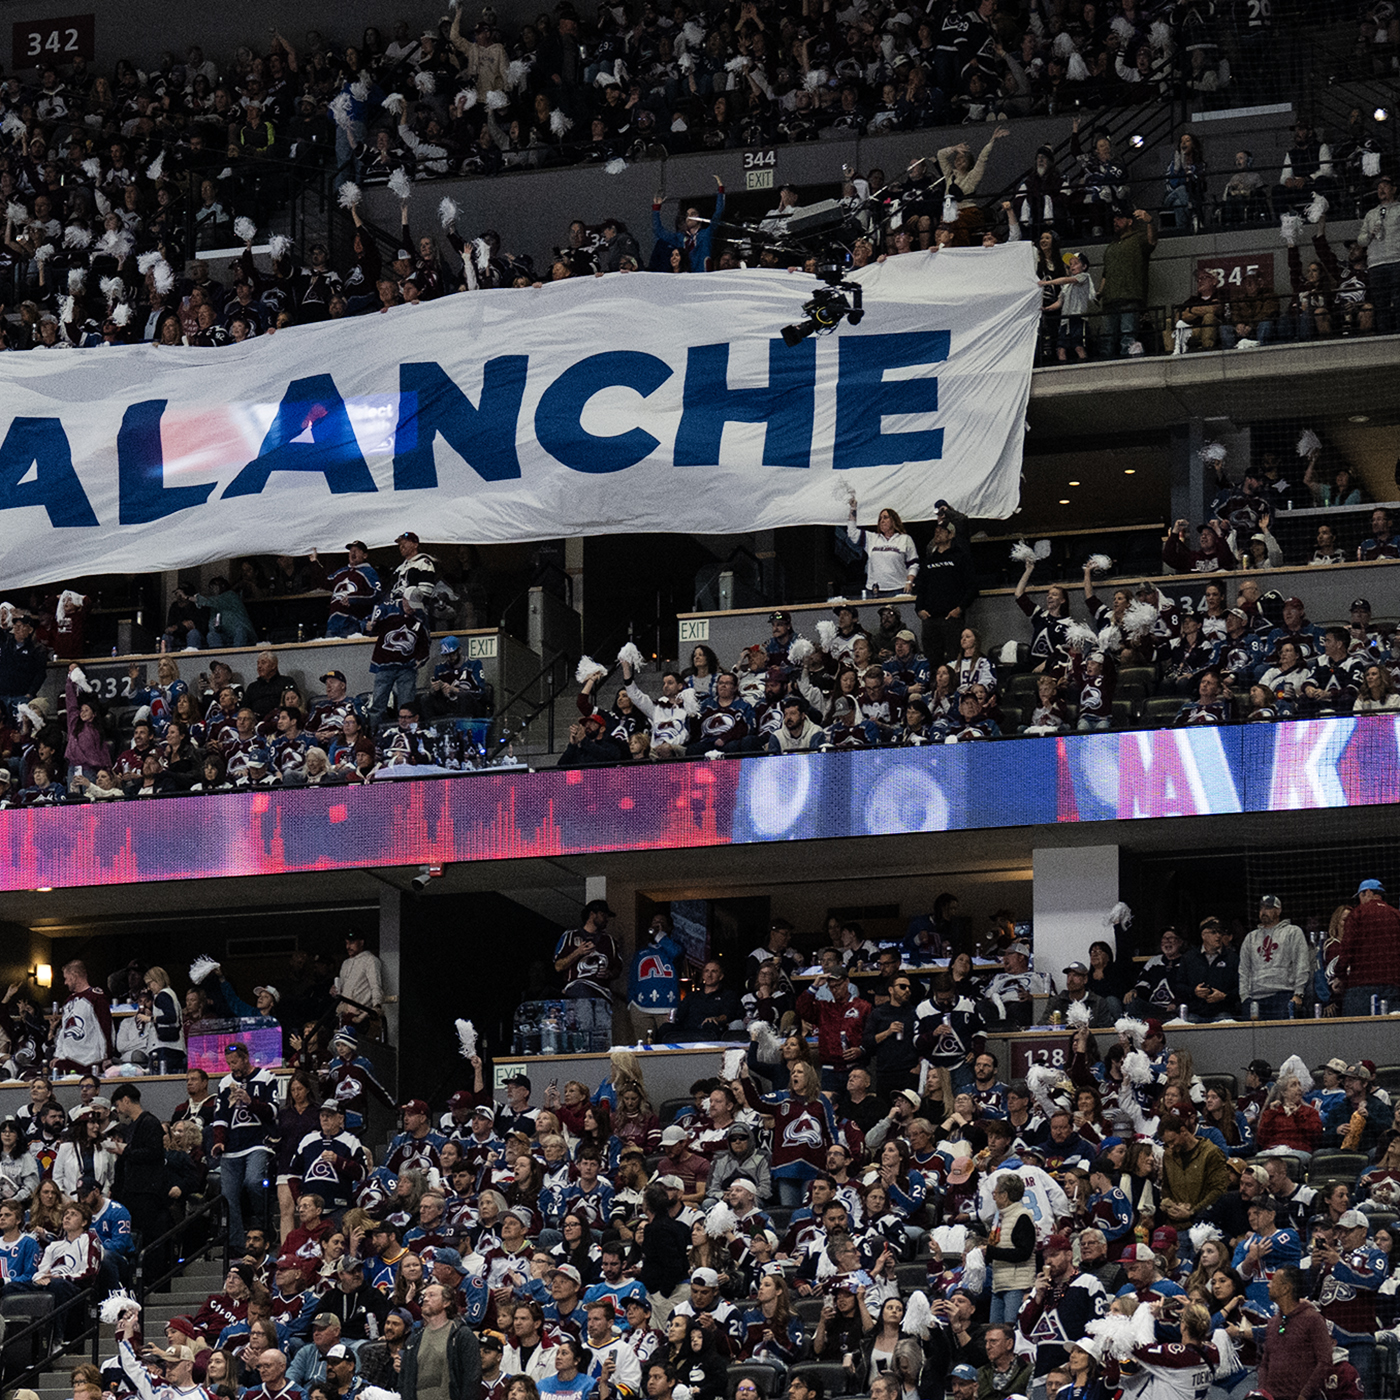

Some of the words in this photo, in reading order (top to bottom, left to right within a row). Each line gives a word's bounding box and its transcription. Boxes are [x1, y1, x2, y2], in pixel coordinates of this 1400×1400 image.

[28, 29, 79, 55] 342
[744, 152, 776, 168] 344
[749, 172, 771, 188] EXIT
[682, 622, 707, 639] EXIT
[471, 639, 495, 656] EXIT
[1025, 1049, 1064, 1066] 128
[388, 1179, 396, 1190] 9
[118, 1220, 131, 1233] 29
[11, 1248, 18, 1258] C
[863, 1242, 873, 1256] 8
[1374, 1259, 1383, 1270] 9
